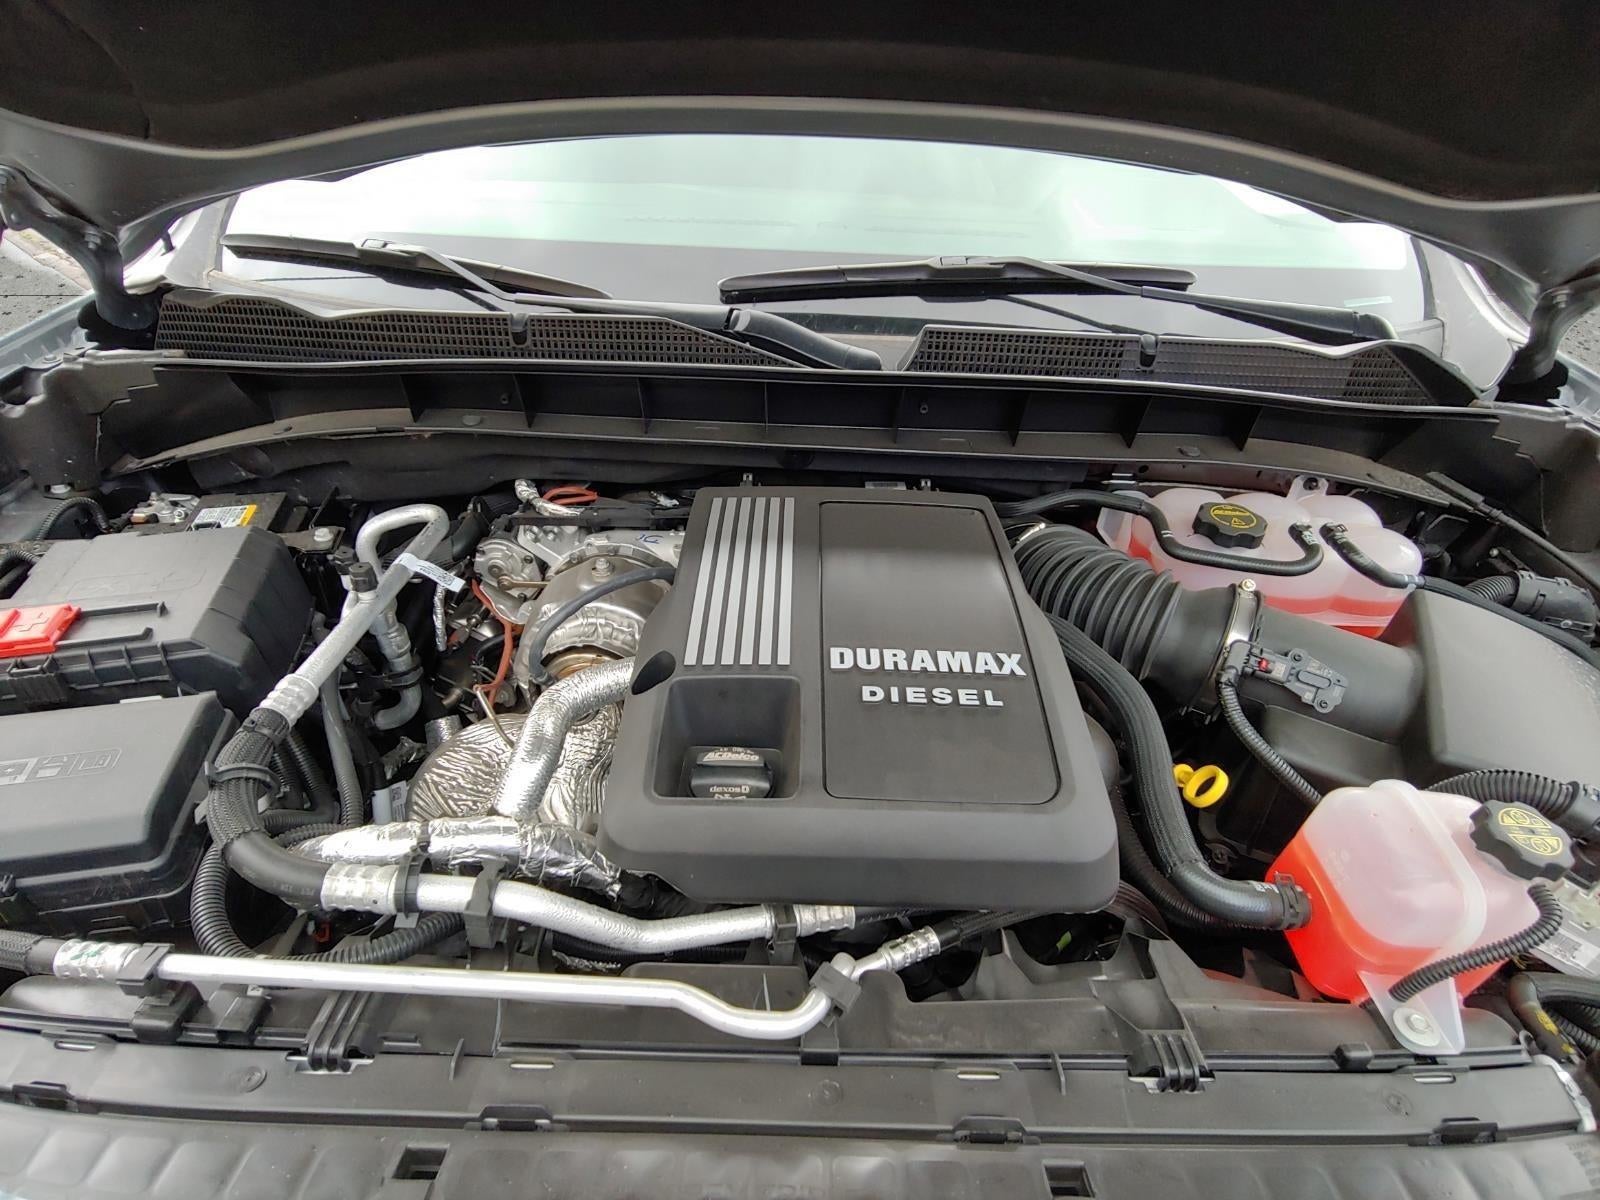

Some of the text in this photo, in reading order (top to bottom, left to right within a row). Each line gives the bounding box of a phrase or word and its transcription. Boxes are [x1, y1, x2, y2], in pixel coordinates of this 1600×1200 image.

[830, 647, 1027, 676] DURAMAX
[862, 685, 1004, 707] DIESEL
[702, 751, 760, 762] ACDelco
